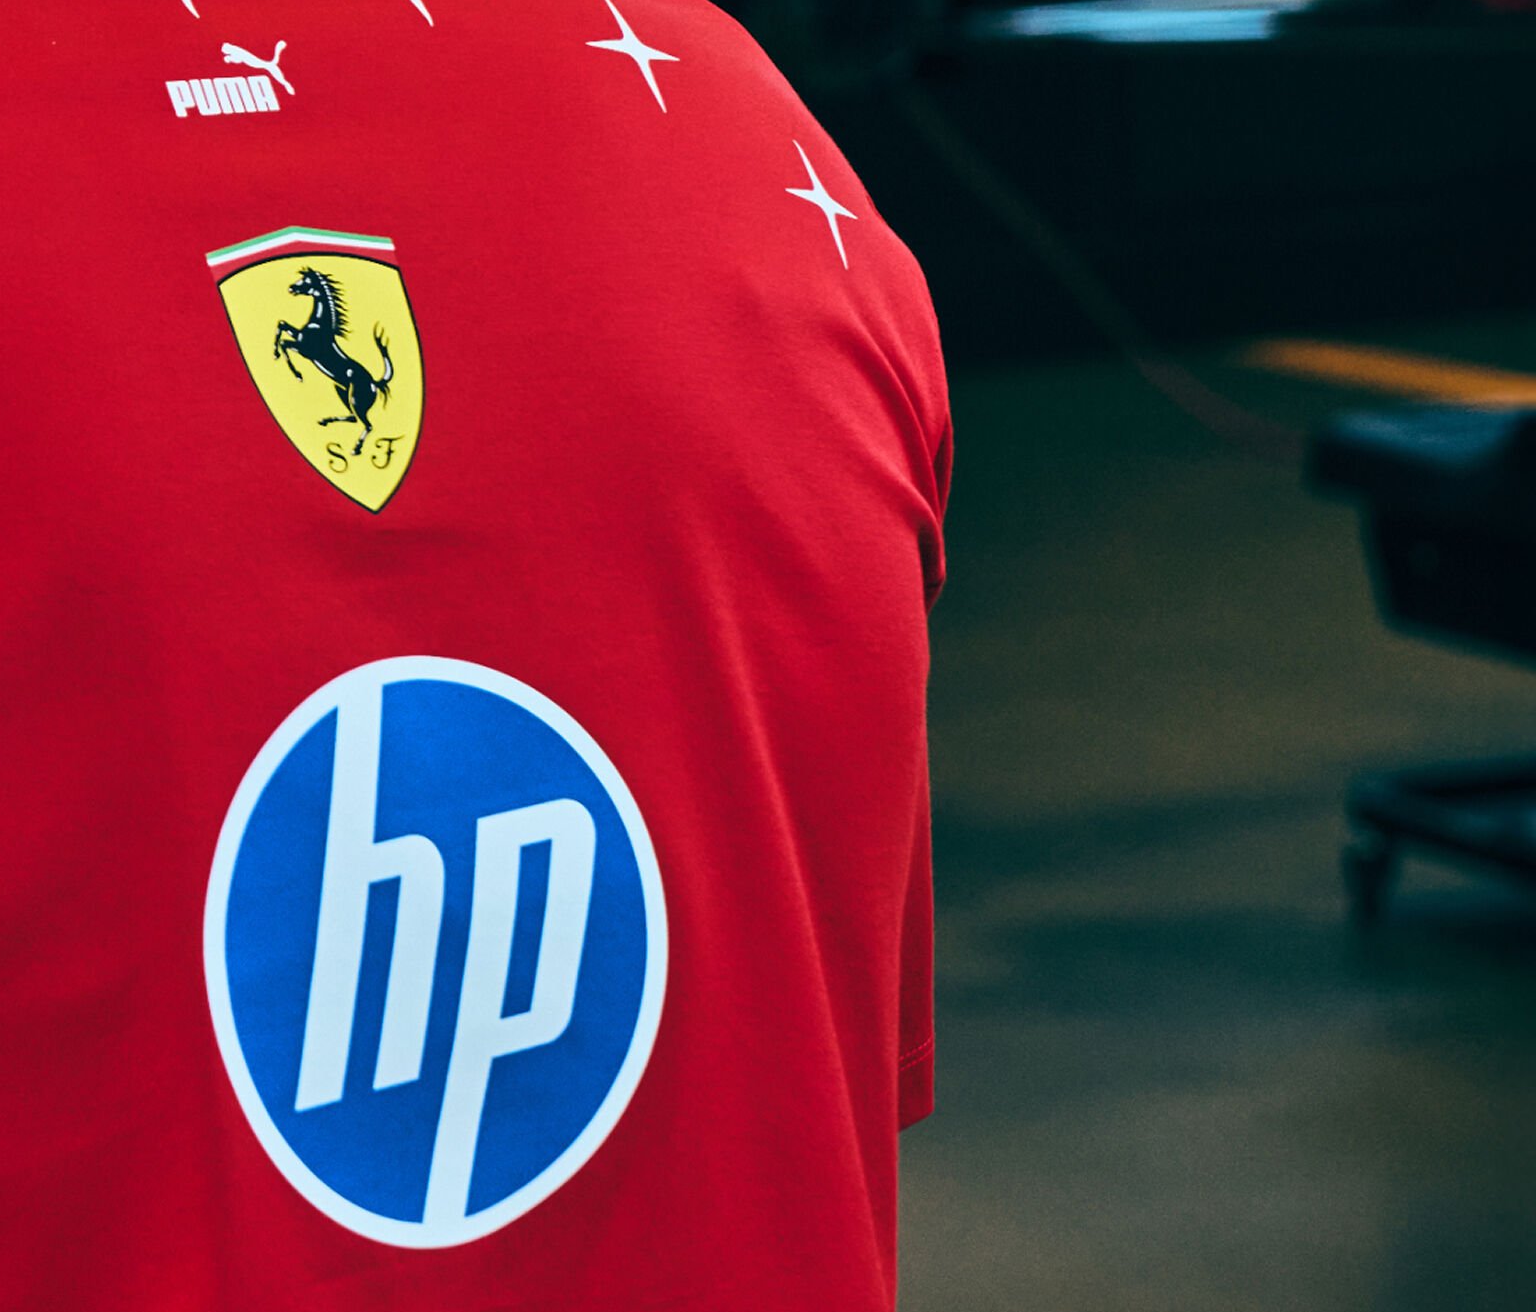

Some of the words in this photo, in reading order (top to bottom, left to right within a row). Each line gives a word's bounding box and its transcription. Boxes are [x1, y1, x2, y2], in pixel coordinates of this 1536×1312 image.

[165, 74, 281, 118] PUMA
[326, 442, 348, 474] S
[371, 434, 406, 470] F
[294, 665, 597, 1229] hp
